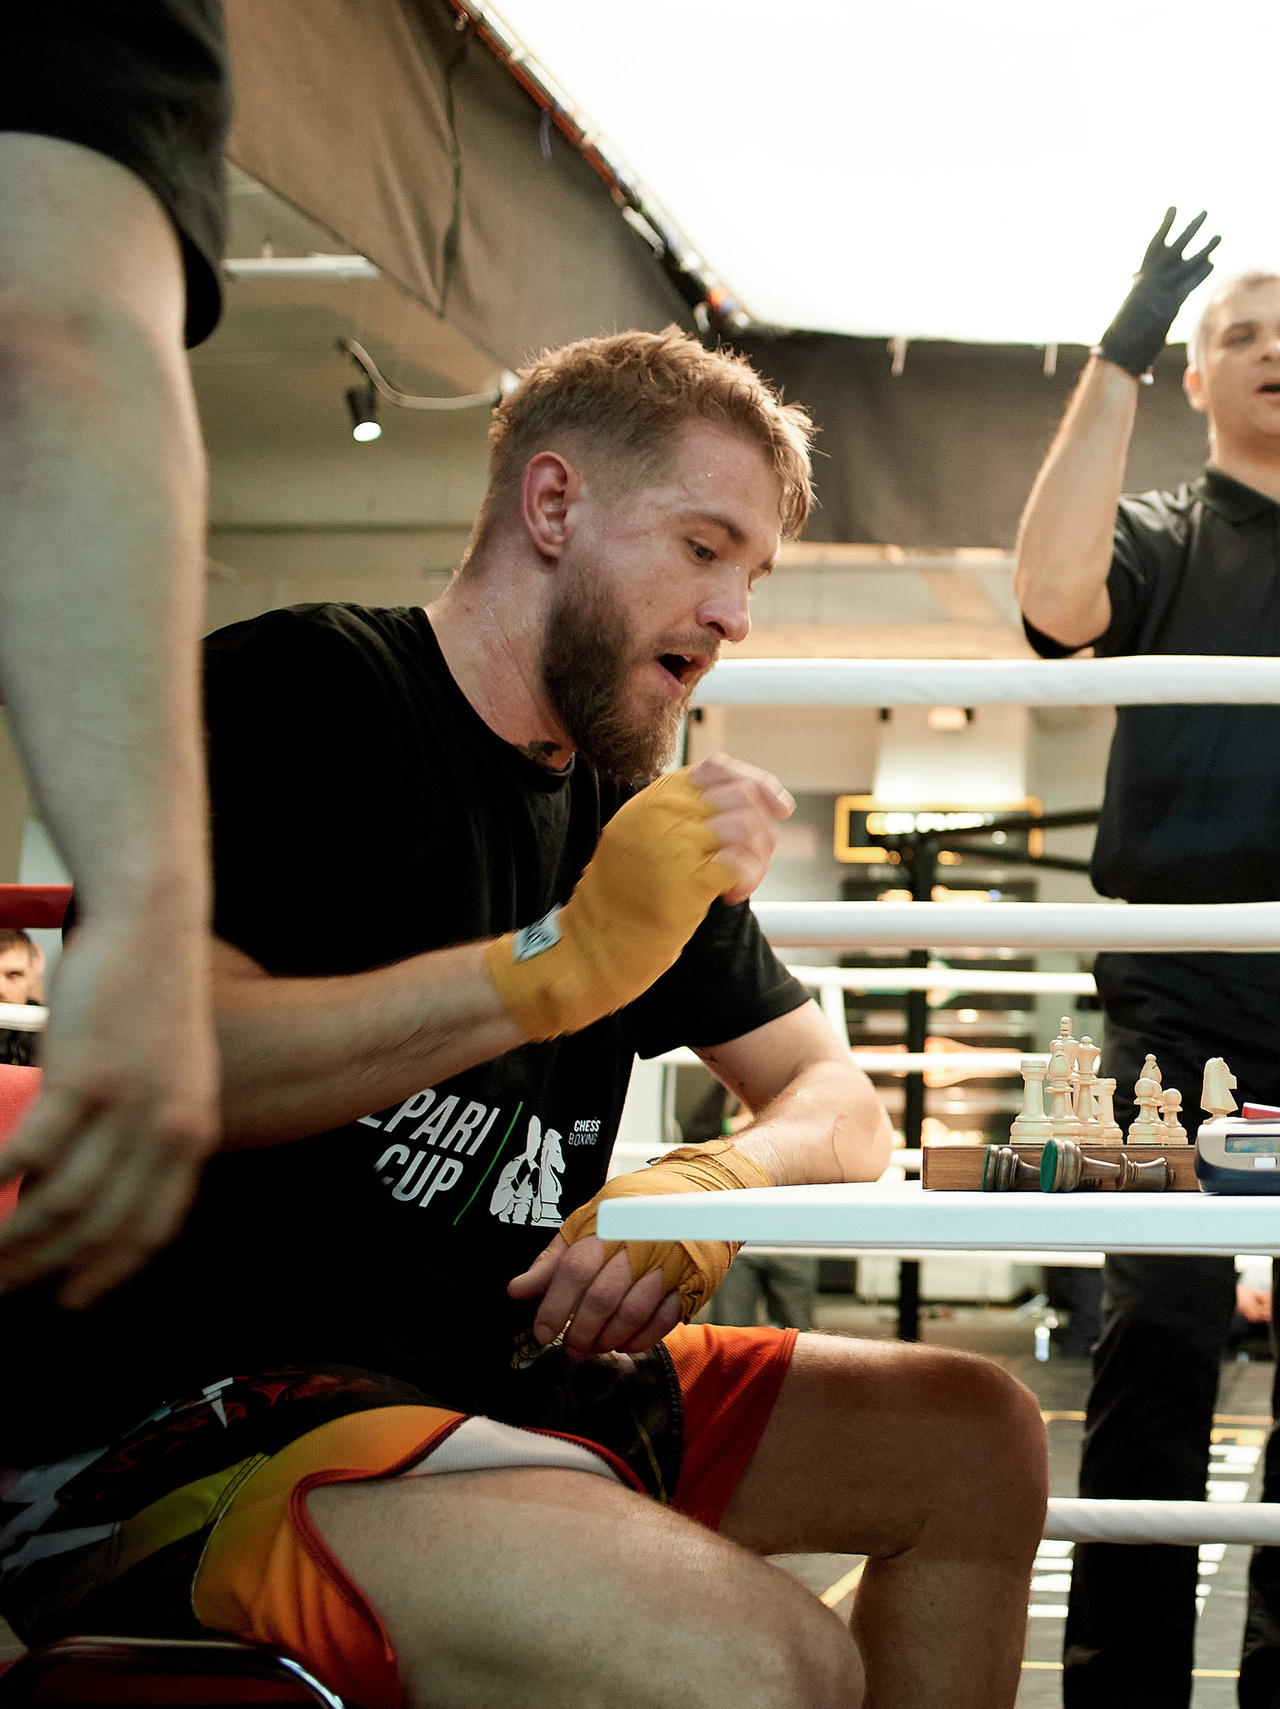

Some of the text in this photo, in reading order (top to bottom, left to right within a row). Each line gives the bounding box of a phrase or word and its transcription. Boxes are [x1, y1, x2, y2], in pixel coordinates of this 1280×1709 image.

[357, 1088, 501, 1157] PARI
[567, 1132, 599, 1147] BOXING
[573, 1119, 602, 1133] CHESS
[373, 1143, 465, 1208] CUP
